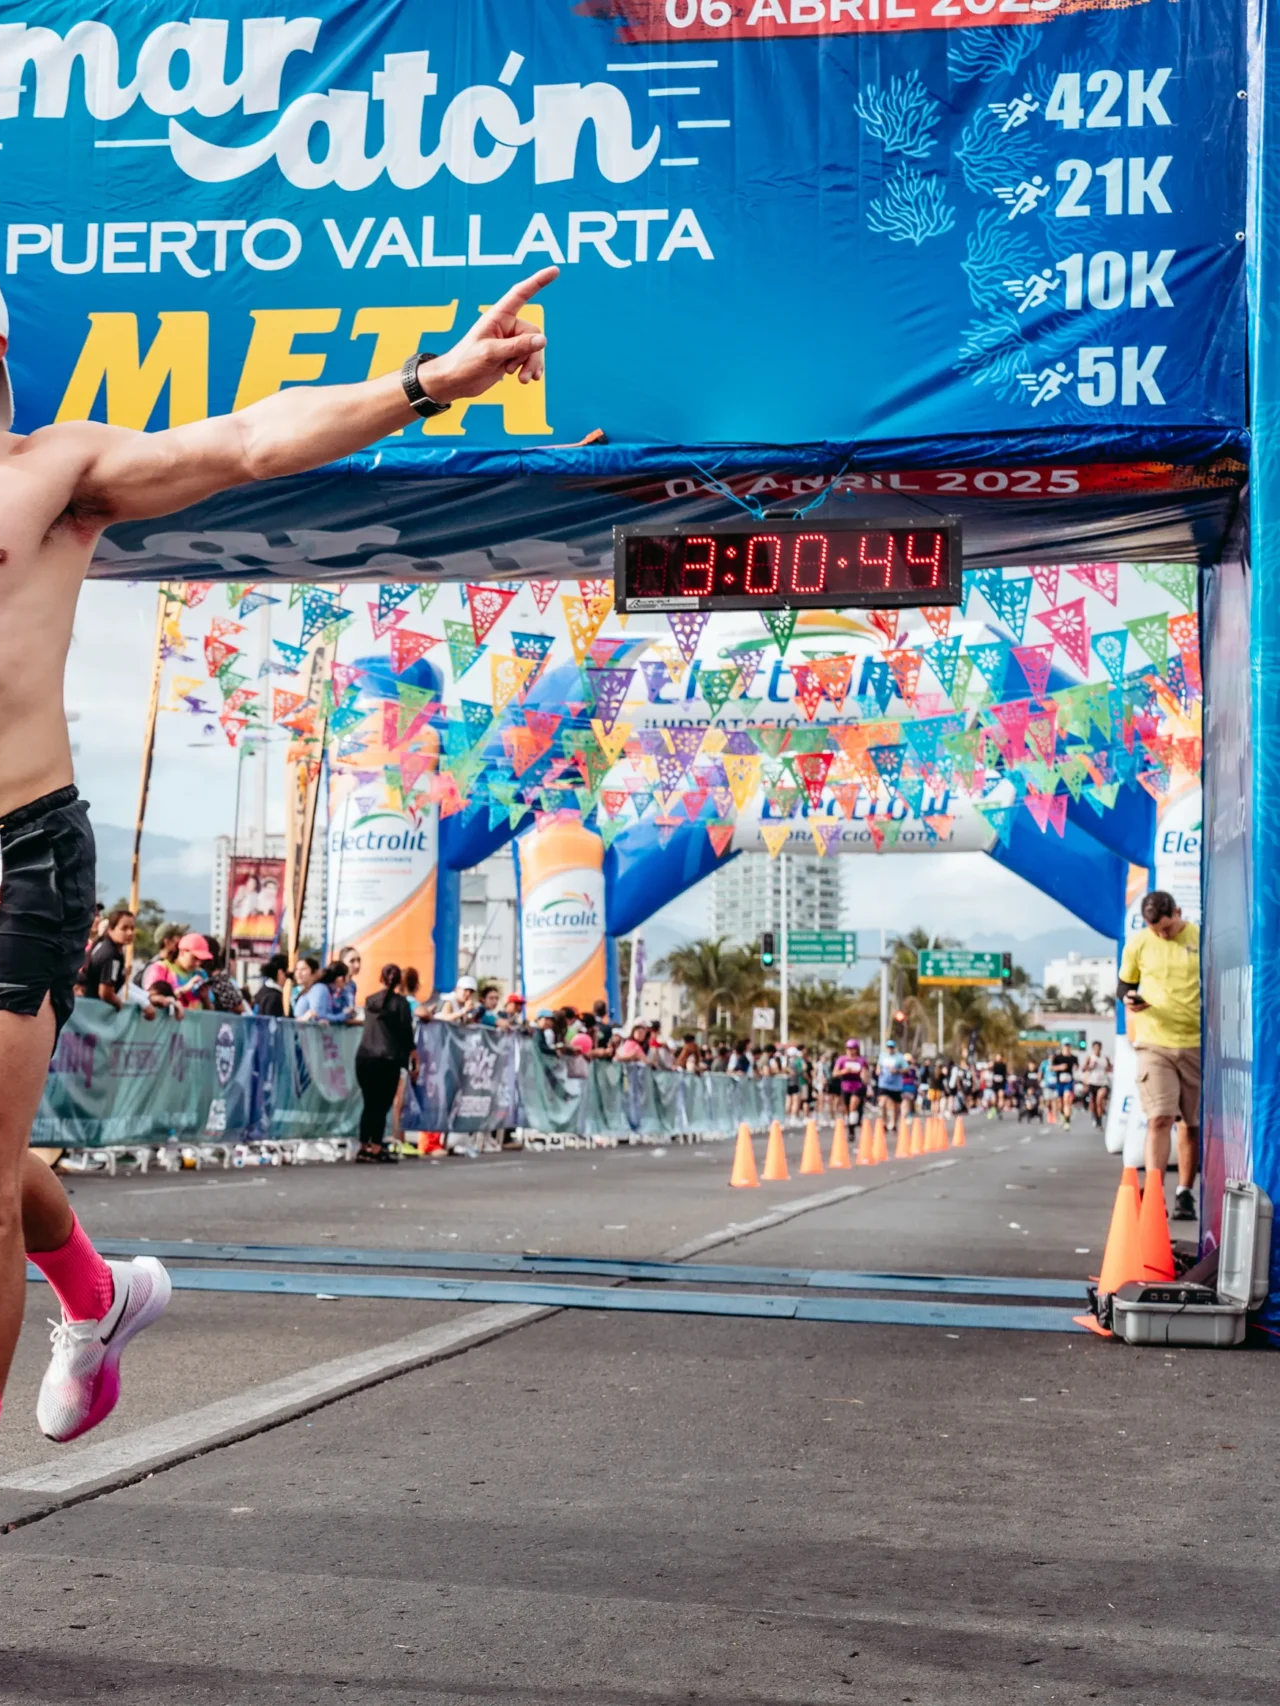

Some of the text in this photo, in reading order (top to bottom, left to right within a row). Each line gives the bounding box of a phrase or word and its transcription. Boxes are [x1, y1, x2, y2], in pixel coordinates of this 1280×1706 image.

[1045, 68, 1173, 130] 42K
[1054, 156, 1173, 218] 21K
[5, 209, 715, 279] PUERTO VALLARTA
[1055, 250, 1177, 311] 10K
[53, 299, 554, 436] META
[1076, 345, 1167, 406] 5K
[935, 469, 1080, 493] 2025
[332, 830, 429, 852] Electrolit
[525, 911, 599, 929] Electrolit
